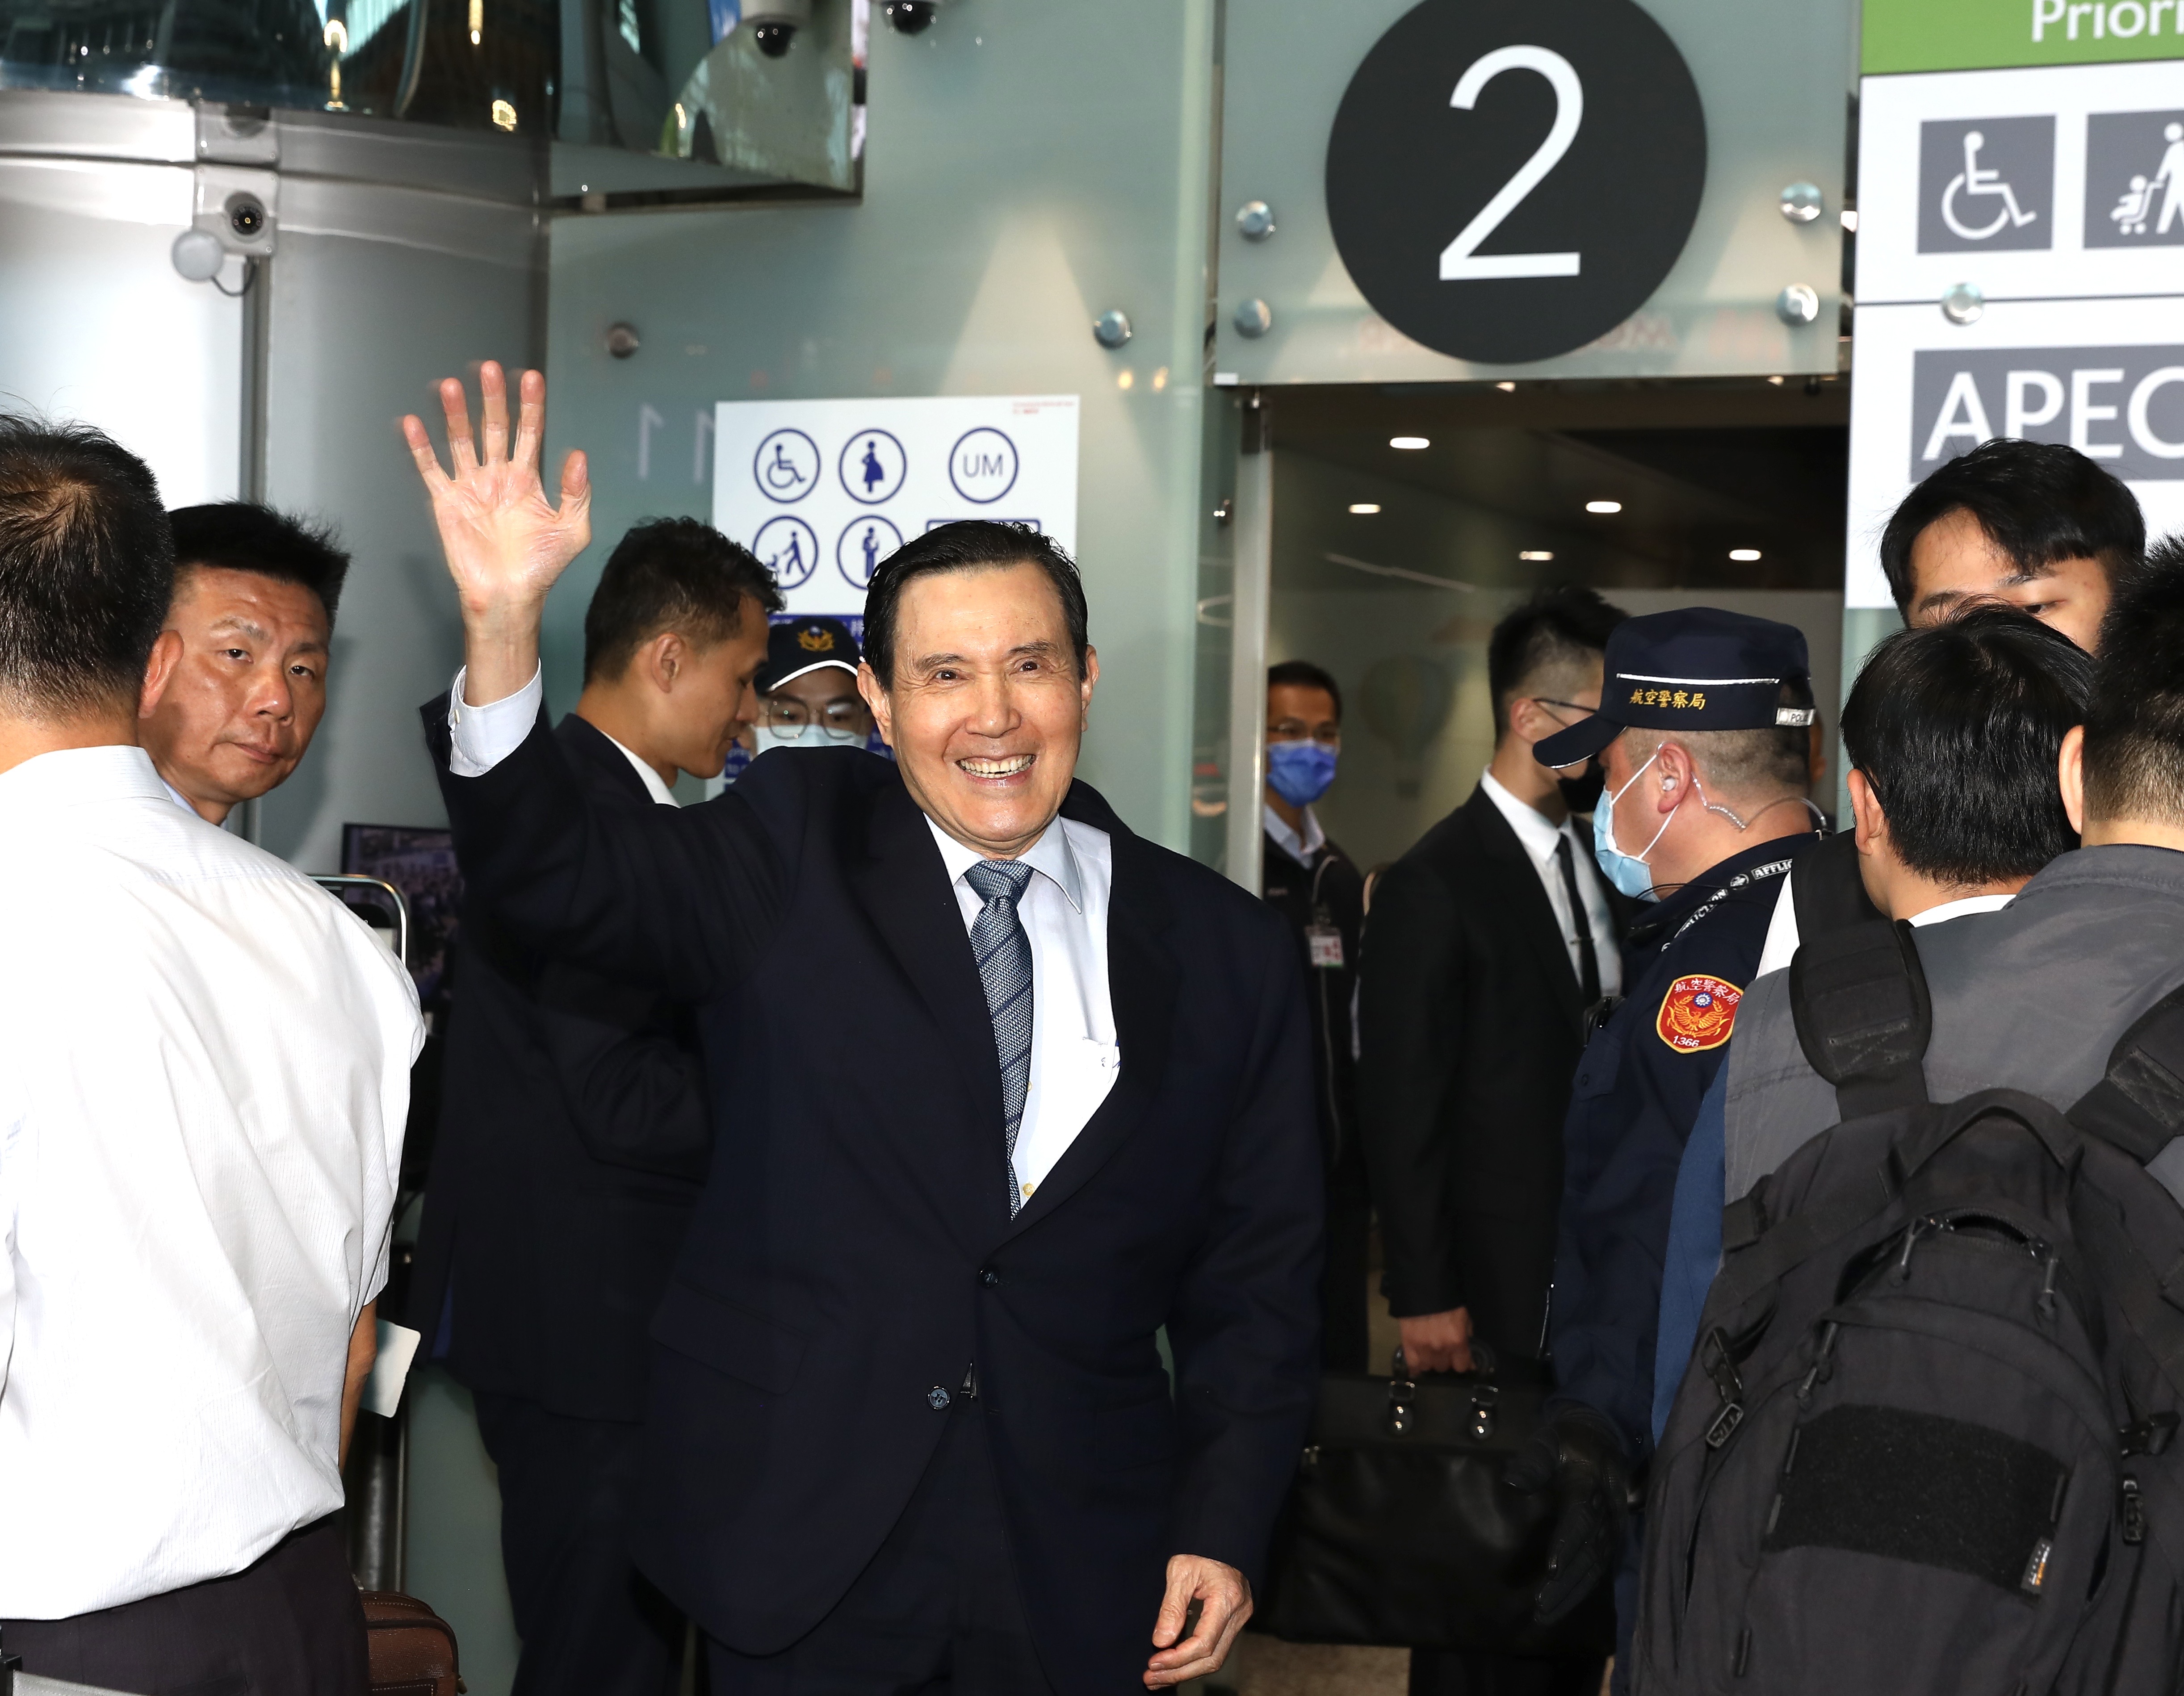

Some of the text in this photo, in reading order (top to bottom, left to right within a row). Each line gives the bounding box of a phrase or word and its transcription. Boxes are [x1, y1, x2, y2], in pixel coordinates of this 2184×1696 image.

[1439, 45, 1584, 281] 2
[963, 454, 1004, 478] UM
[1629, 689, 1706, 710] 航空警察局
[1674, 978, 1740, 1005] 航空警察局
[1673, 1035, 1700, 1047] 1366
